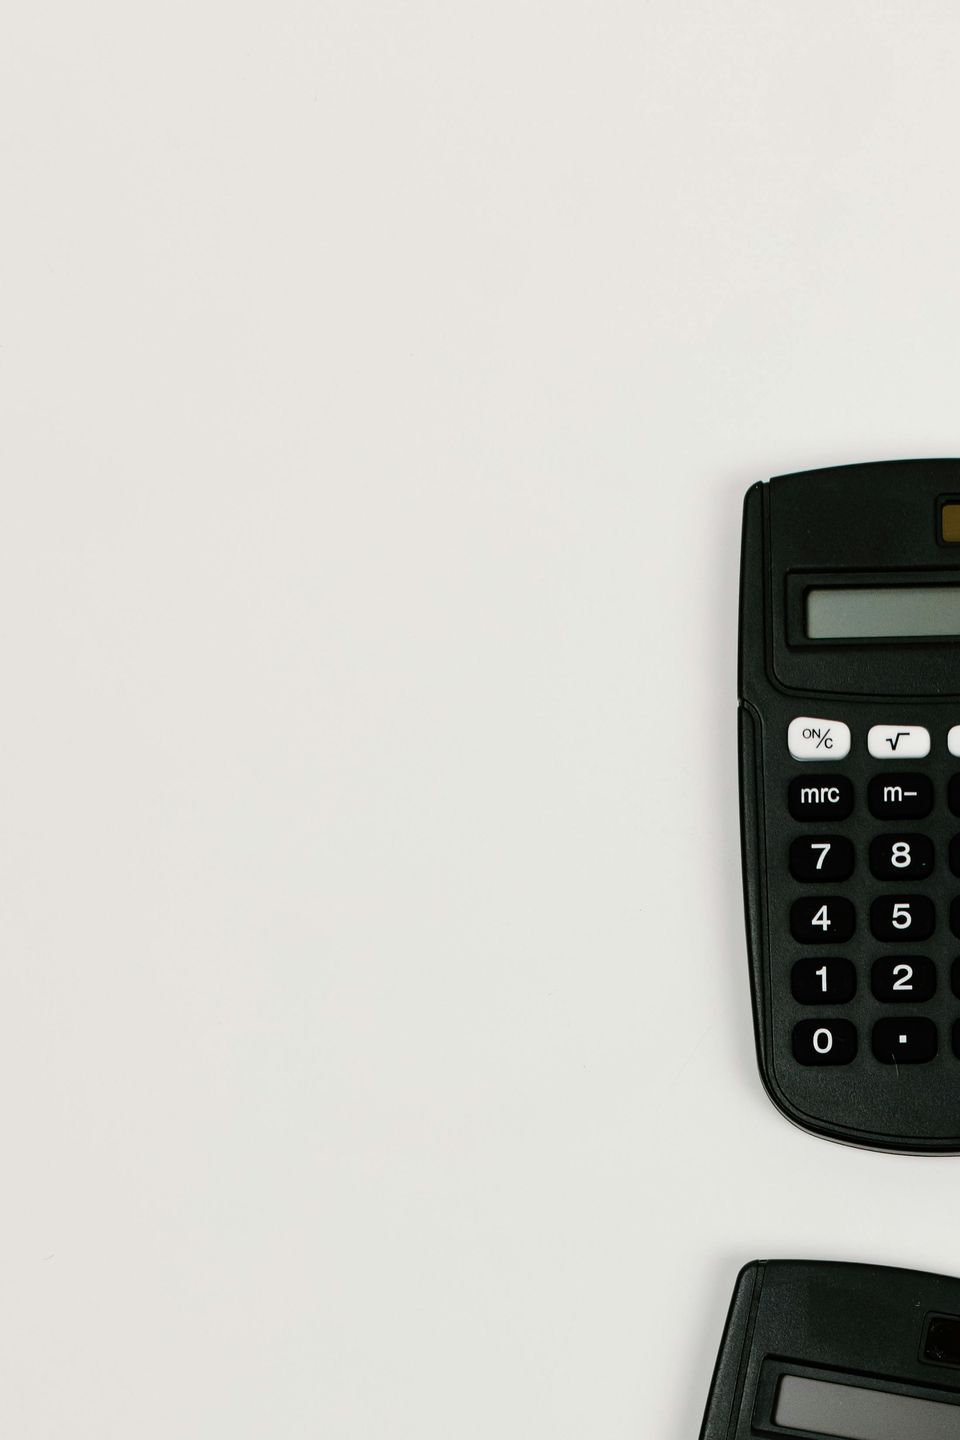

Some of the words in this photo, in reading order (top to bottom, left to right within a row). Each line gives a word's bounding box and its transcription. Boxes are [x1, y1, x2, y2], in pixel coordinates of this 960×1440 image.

[800, 787, 840, 804] mrc
[810, 843, 831, 870] 7
[890, 841, 912, 868] 8
[811, 904, 832, 932] 4
[891, 903, 912, 930] 5
[815, 965, 828, 992] 1
[892, 964, 914, 991] 2
[812, 1027, 833, 1054] 0
